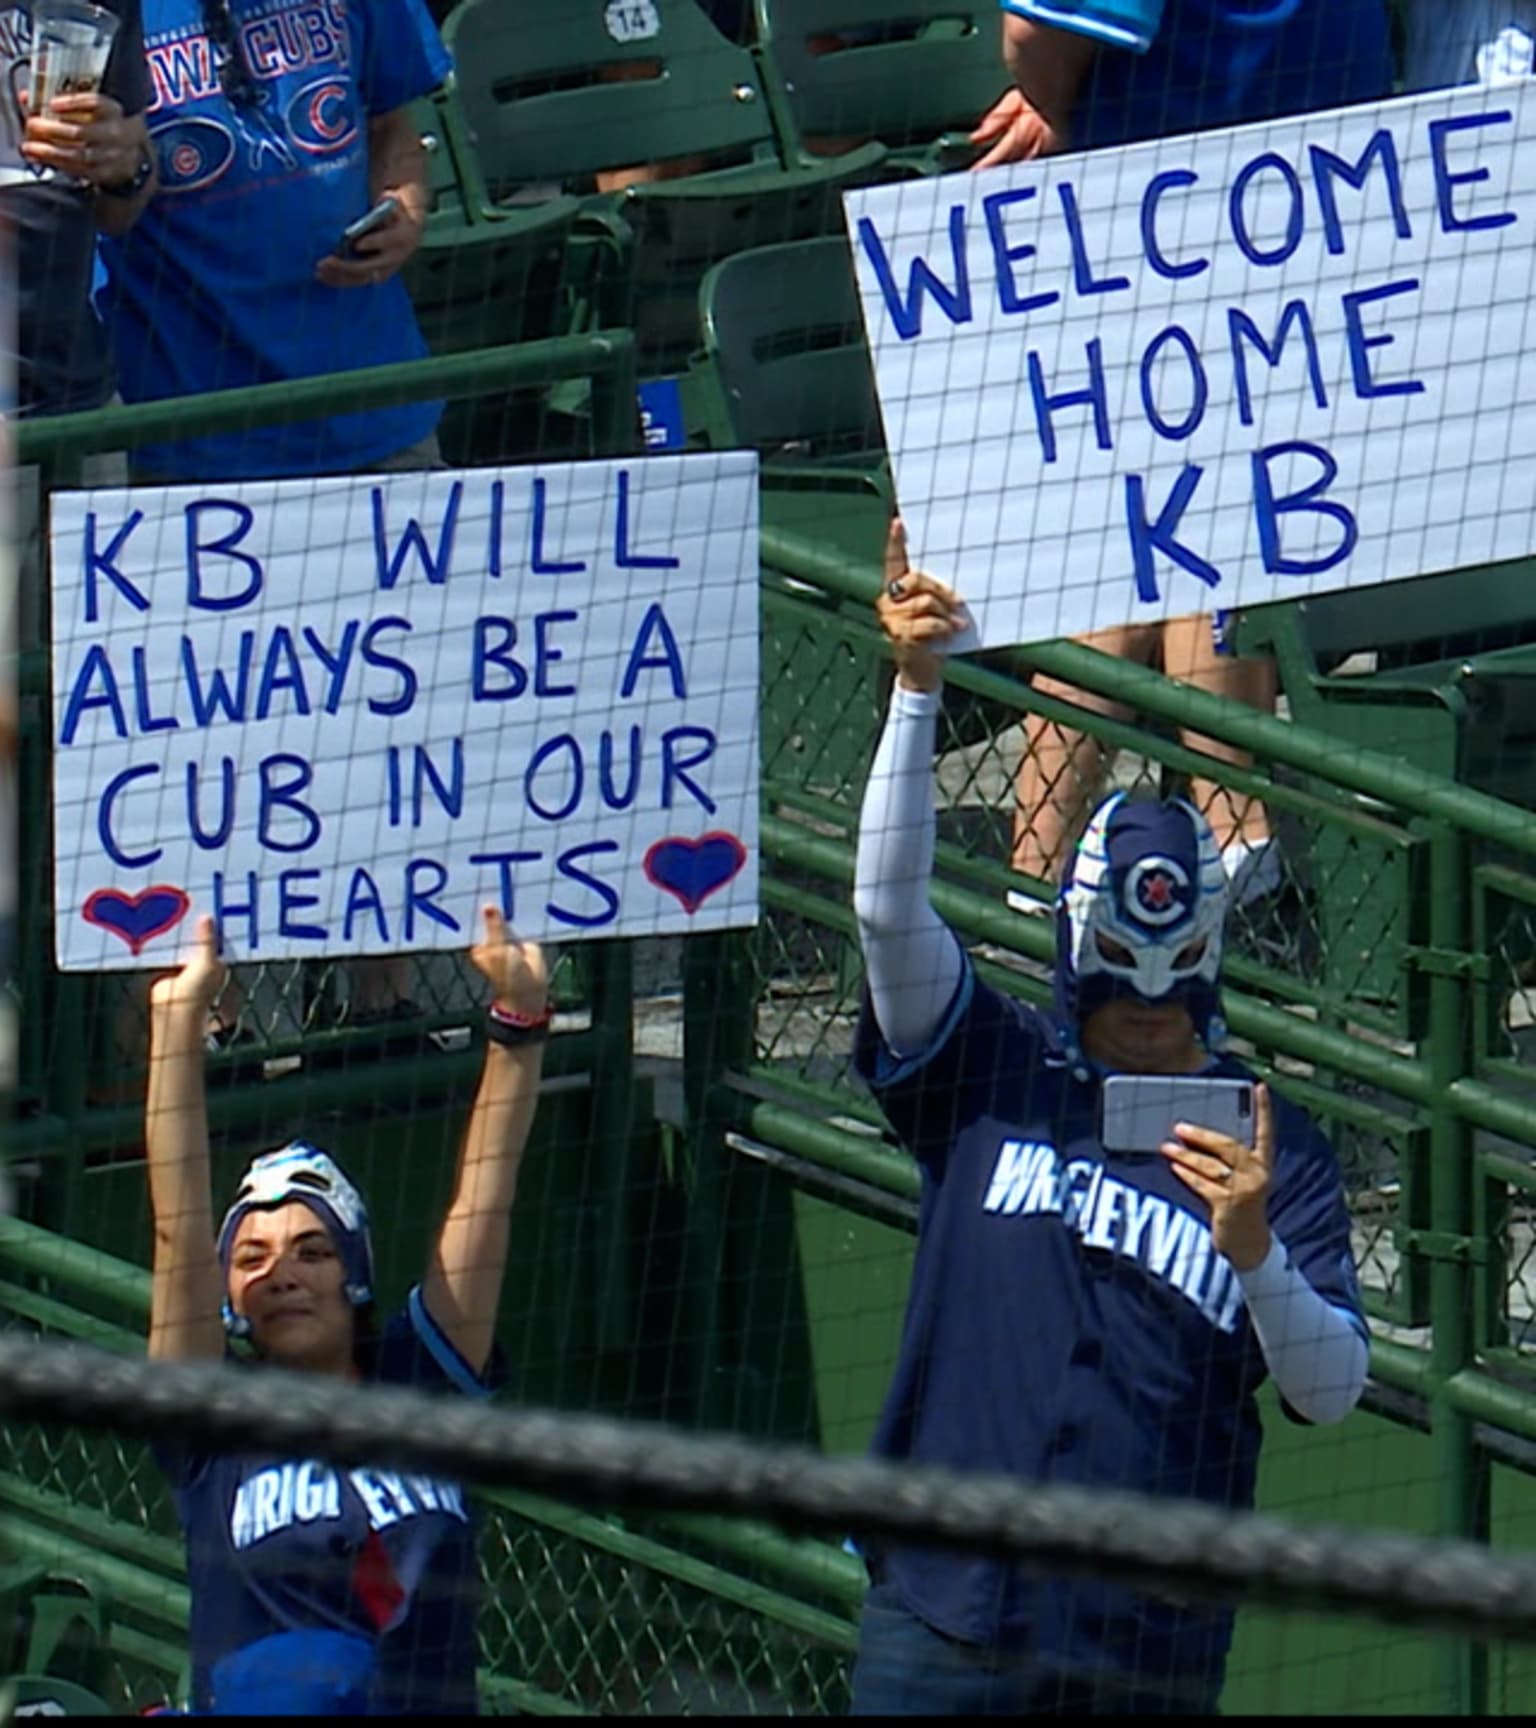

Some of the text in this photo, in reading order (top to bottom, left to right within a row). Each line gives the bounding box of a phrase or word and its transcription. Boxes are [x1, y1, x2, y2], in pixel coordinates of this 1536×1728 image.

[616, 6, 646, 34] 14
[857, 111, 1517, 341] WELCOME
[1026, 278, 1425, 463] HOME
[82, 470, 679, 623] KB WILL
[1125, 442, 1357, 603] KB
[59, 603, 686, 746] ALWAYS BE A
[97, 724, 718, 869] CUB IN OUR
[211, 840, 620, 953] HEARTS
